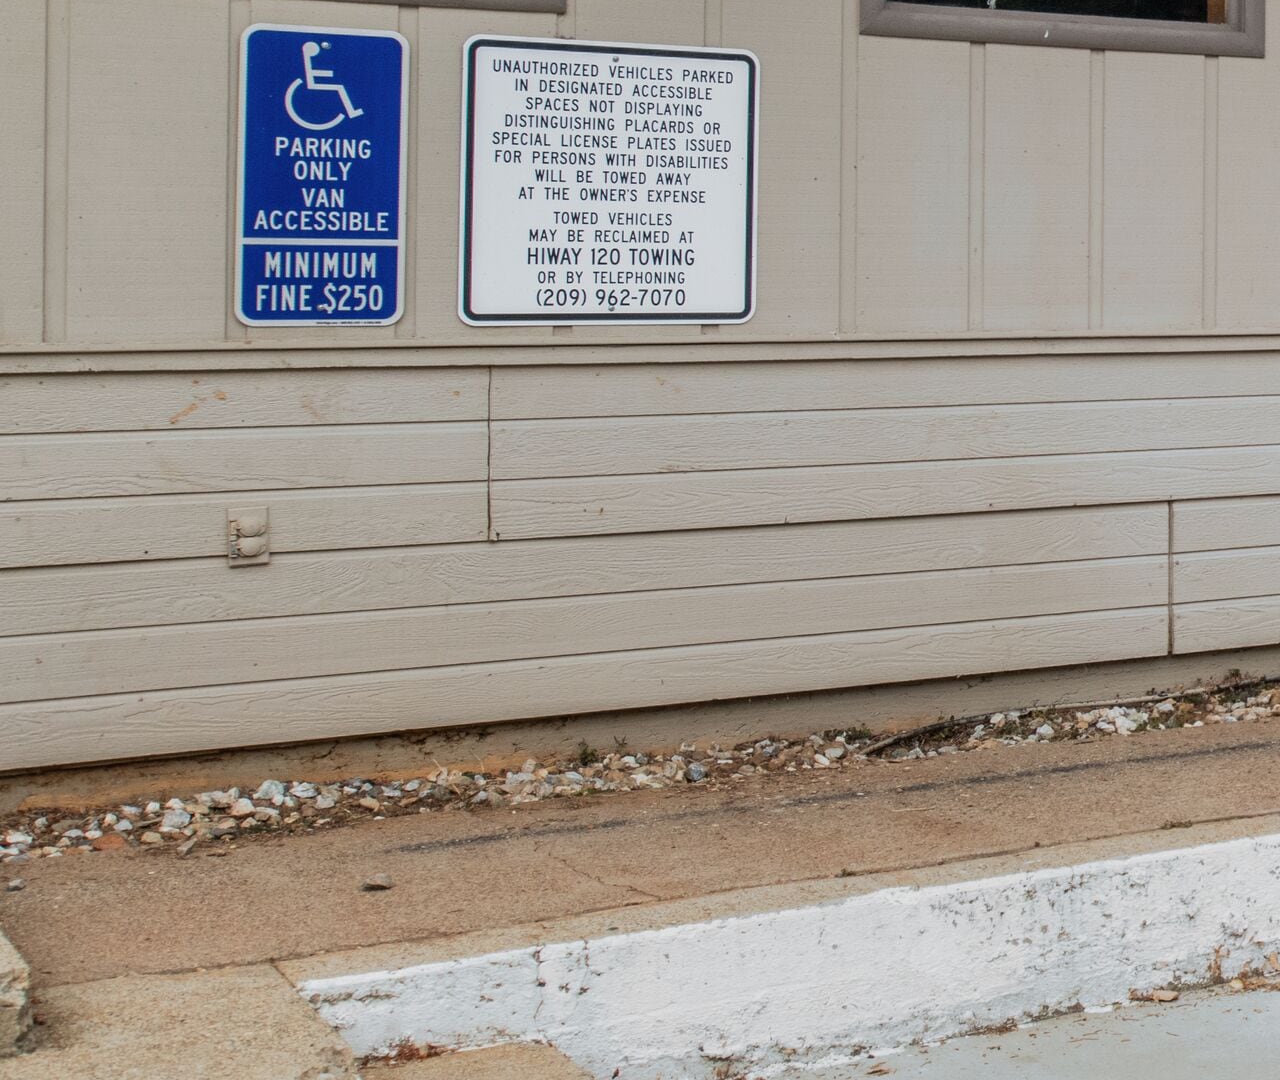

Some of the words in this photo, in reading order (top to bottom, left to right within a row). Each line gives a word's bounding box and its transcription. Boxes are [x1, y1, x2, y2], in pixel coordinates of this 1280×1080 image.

[493, 59, 598, 77] UNAUTHORIZED
[609, 66, 672, 81] VEHICLES
[683, 69, 733, 84] PARKED
[515, 78, 528, 91] IN
[540, 80, 622, 96] DESIGNATED
[632, 84, 712, 100] ACCESSIBLE
[526, 97, 579, 111] SPACES
[590, 100, 615, 113] NOT
[625, 102, 702, 117] DISPLAYING
[505, 114, 614, 131] DISTINGUISHING
[626, 119, 693, 134] PLACARDS
[704, 122, 720, 135] OR
[275, 137, 371, 159] PARKING
[492, 132, 551, 146] SPECIAL
[561, 134, 617, 148] LICENSE
[628, 137, 676, 150] PLATES
[686, 139, 731, 152] ISSUED
[495, 150, 521, 163] FOR
[533, 151, 596, 165] PERSONS
[606, 153, 635, 166] WITH
[647, 155, 728, 169] DISABILITIES
[294, 161, 352, 181] ONLY
[535, 169, 566, 182] WILL
[577, 170, 592, 183] BE
[603, 171, 646, 184] TOWED
[656, 173, 691, 185] AWAY
[302, 188, 344, 208] VAN
[519, 187, 534, 199] AT
[544, 187, 569, 200] THE
[580, 188, 637, 201] OWNER'S
[648, 190, 705, 203] EXPENSE
[254, 210, 388, 231] ACCESSIBLE
[554, 212, 598, 224] TOWED
[609, 213, 672, 226] VEHICLES
[529, 229, 557, 241] MAY
[568, 230, 584, 242] BE
[595, 230, 669, 243] RECLAIMED
[679, 232, 694, 243] AT
[265, 252, 376, 278] MINIMUM
[528, 248, 582, 265] HIWAY
[591, 248, 620, 265] 120
[629, 248, 694, 265] TOWING
[538, 271, 555, 283] OR
[567, 271, 583, 284] BY
[593, 271, 685, 284] TELEPHONING
[256, 284, 312, 311] FINE
[324, 282, 383, 314] $250
[537, 289, 586, 306] (209)
[596, 289, 685, 306] 962-7070
